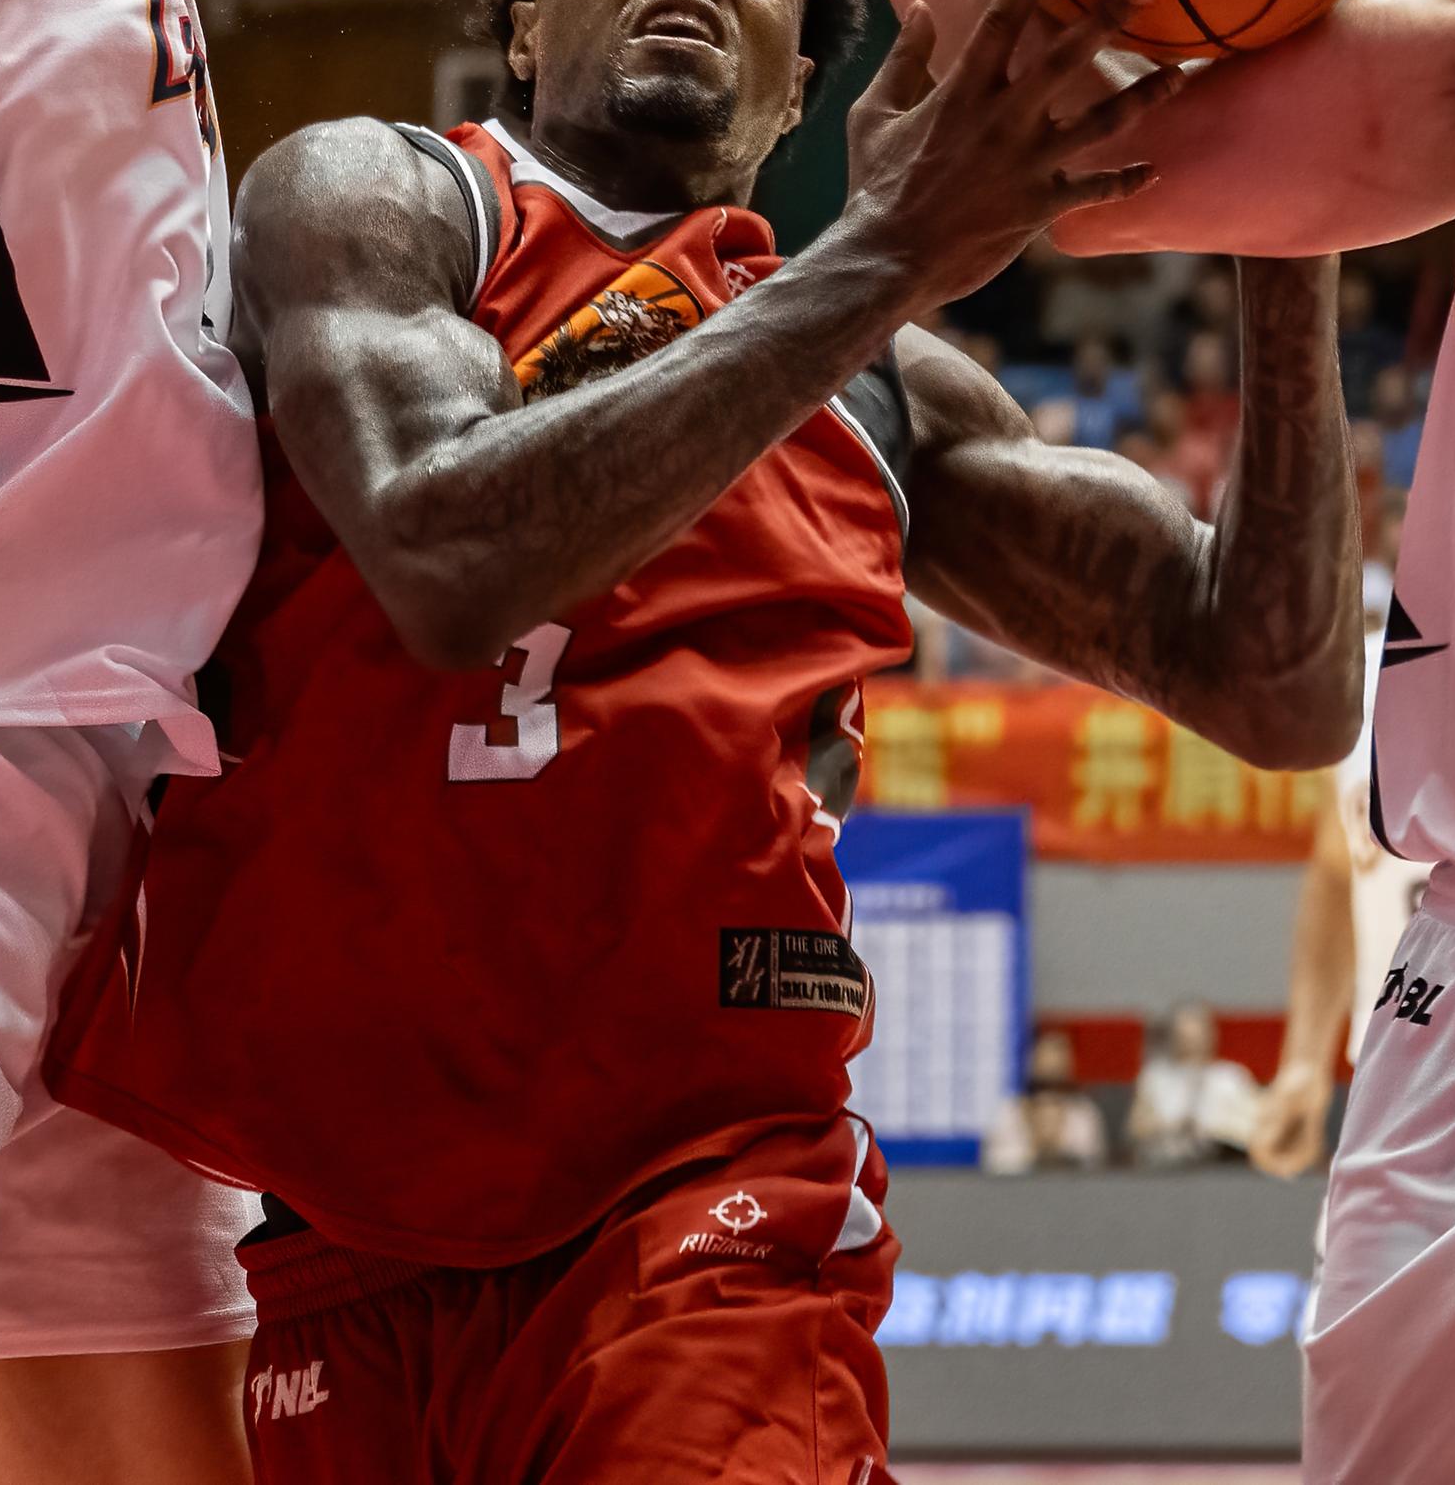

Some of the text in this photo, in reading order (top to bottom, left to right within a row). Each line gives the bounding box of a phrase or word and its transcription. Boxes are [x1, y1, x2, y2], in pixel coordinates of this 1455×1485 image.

[448, 621, 572, 782] 3
[785, 935, 839, 957] THE ONE
